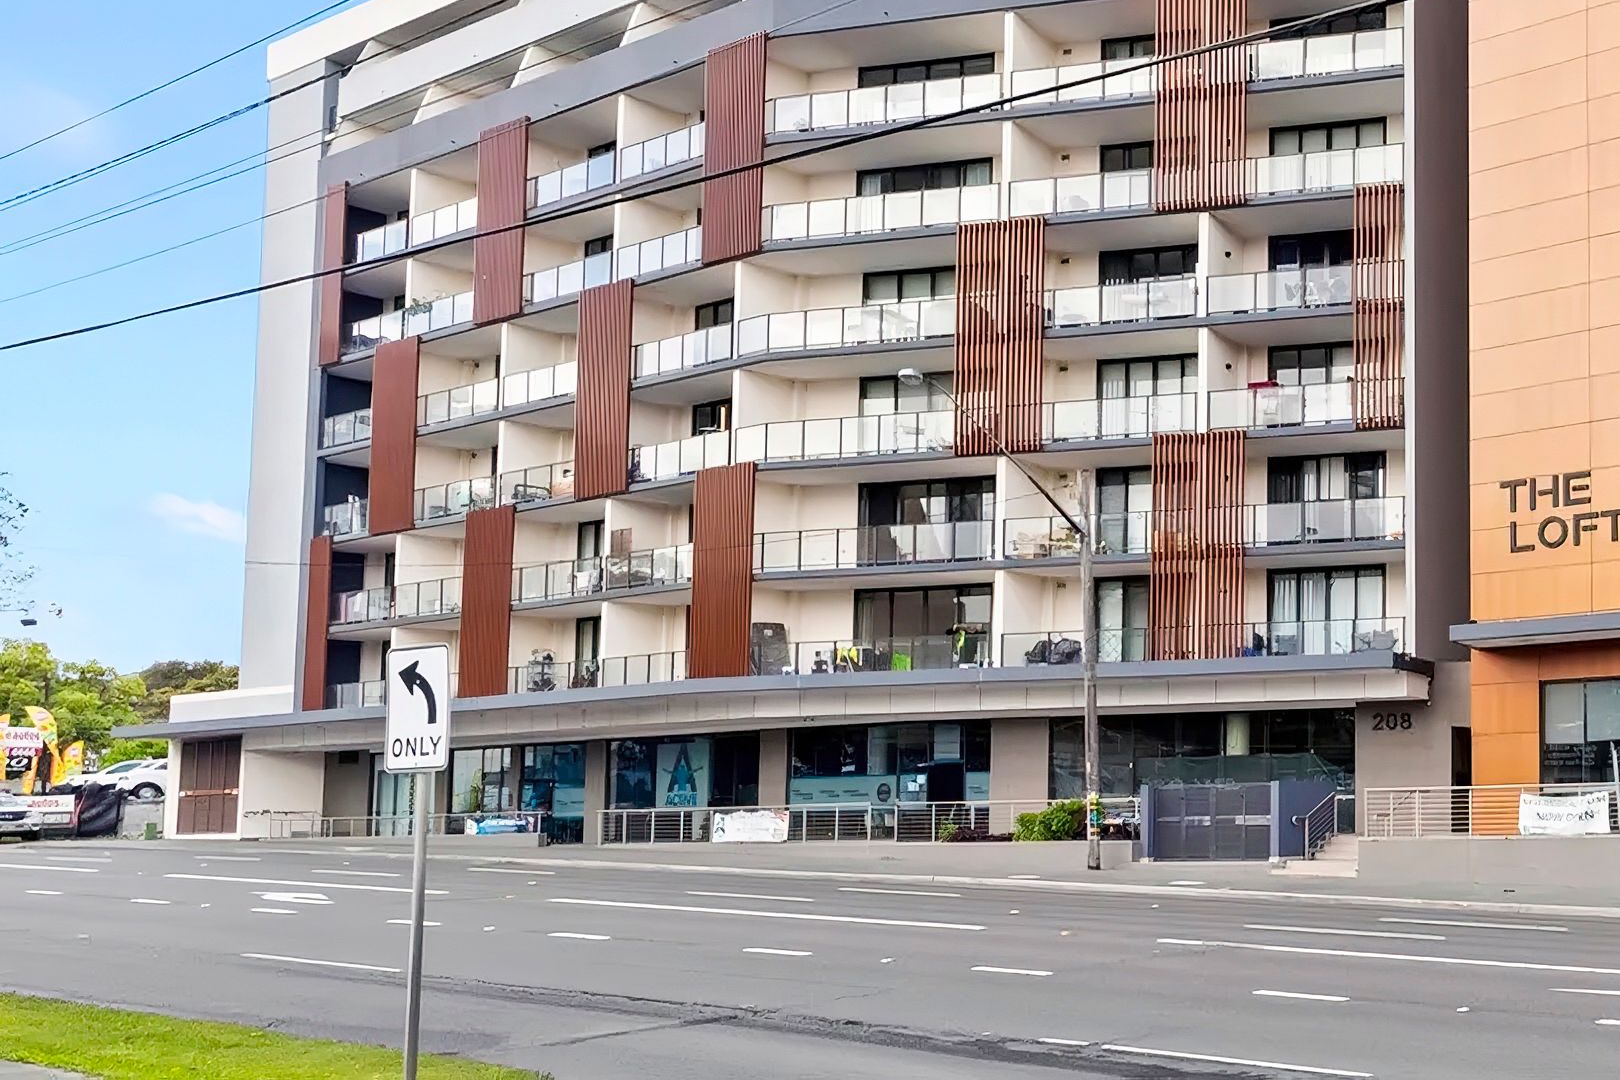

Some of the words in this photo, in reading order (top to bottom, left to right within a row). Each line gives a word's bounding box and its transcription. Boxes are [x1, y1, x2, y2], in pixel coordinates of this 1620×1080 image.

[1499, 470, 1592, 513] THE
[1372, 712, 1412, 731] 208
[392, 735, 442, 758] ONLY
